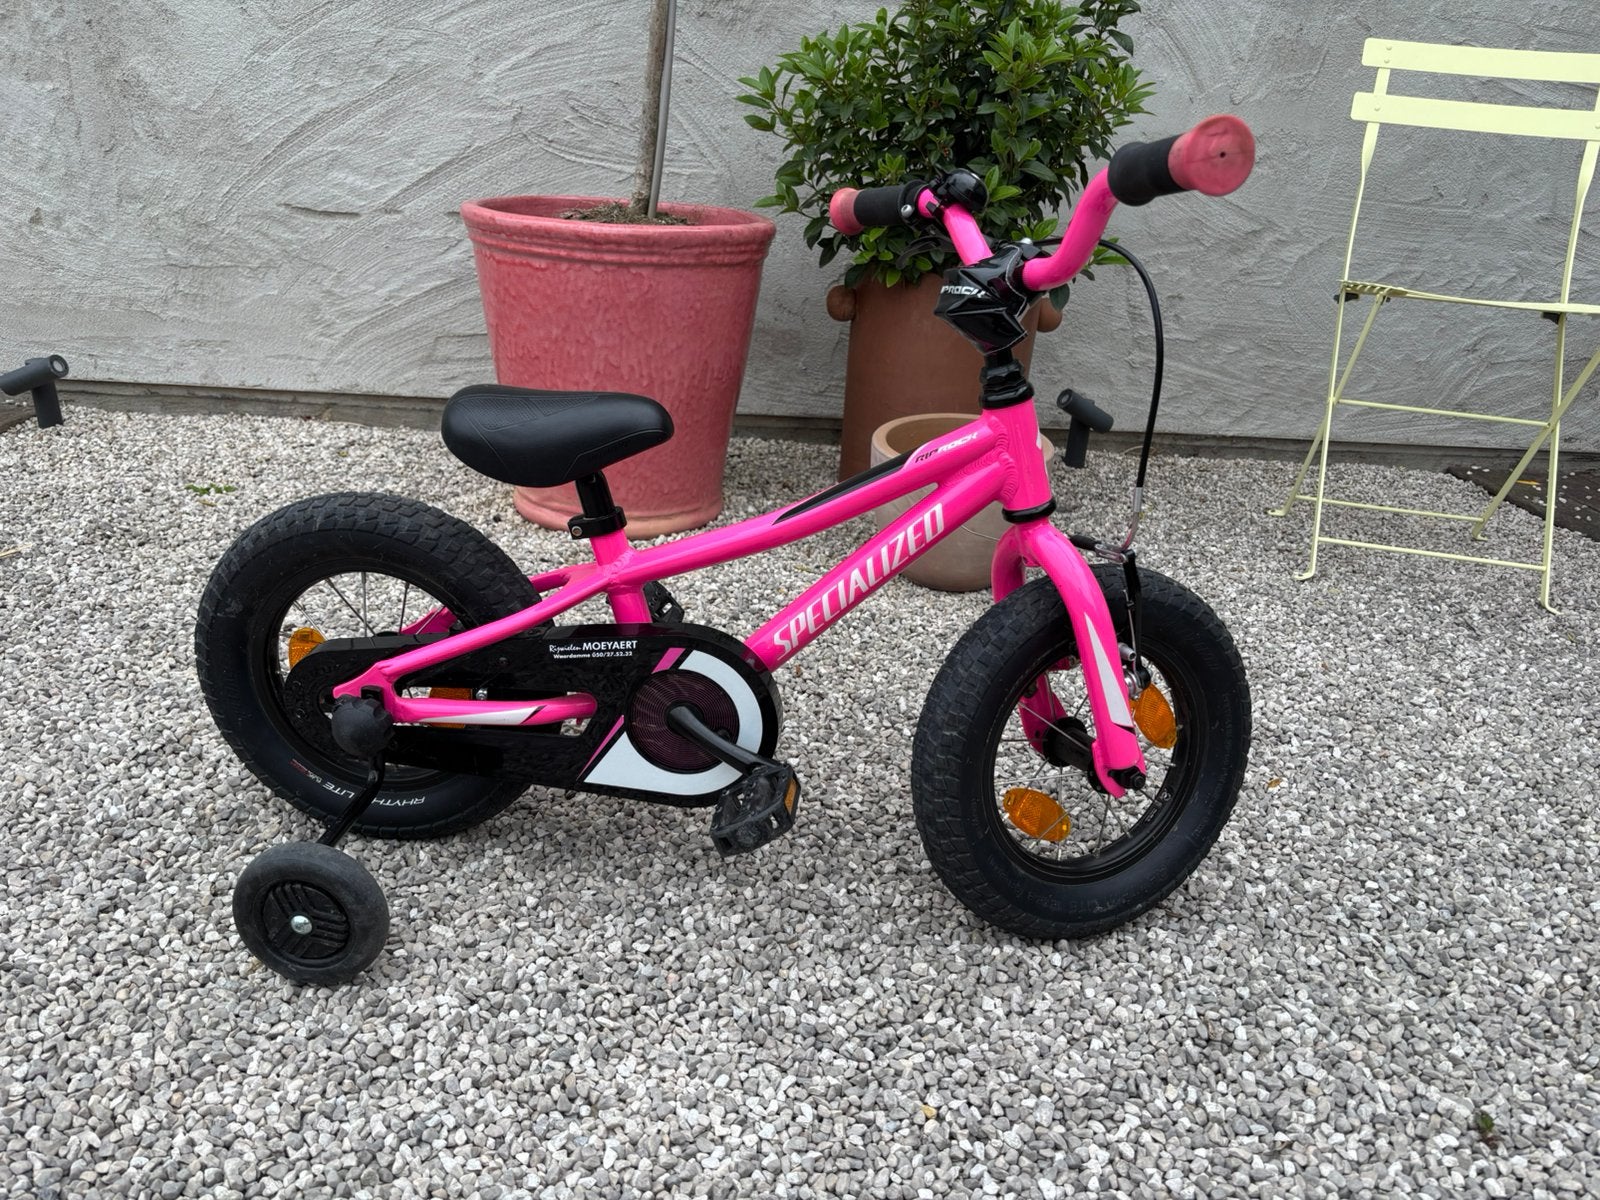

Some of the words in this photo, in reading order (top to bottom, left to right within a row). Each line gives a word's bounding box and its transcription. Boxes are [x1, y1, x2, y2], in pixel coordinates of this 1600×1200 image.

[915, 432, 978, 463] RIPROCK
[773, 503, 945, 661] SPECIALIZED
[582, 641, 638, 651] MOEYAERT
[322, 781, 355, 798] LITE
[371, 796, 426, 807] RHYTH
